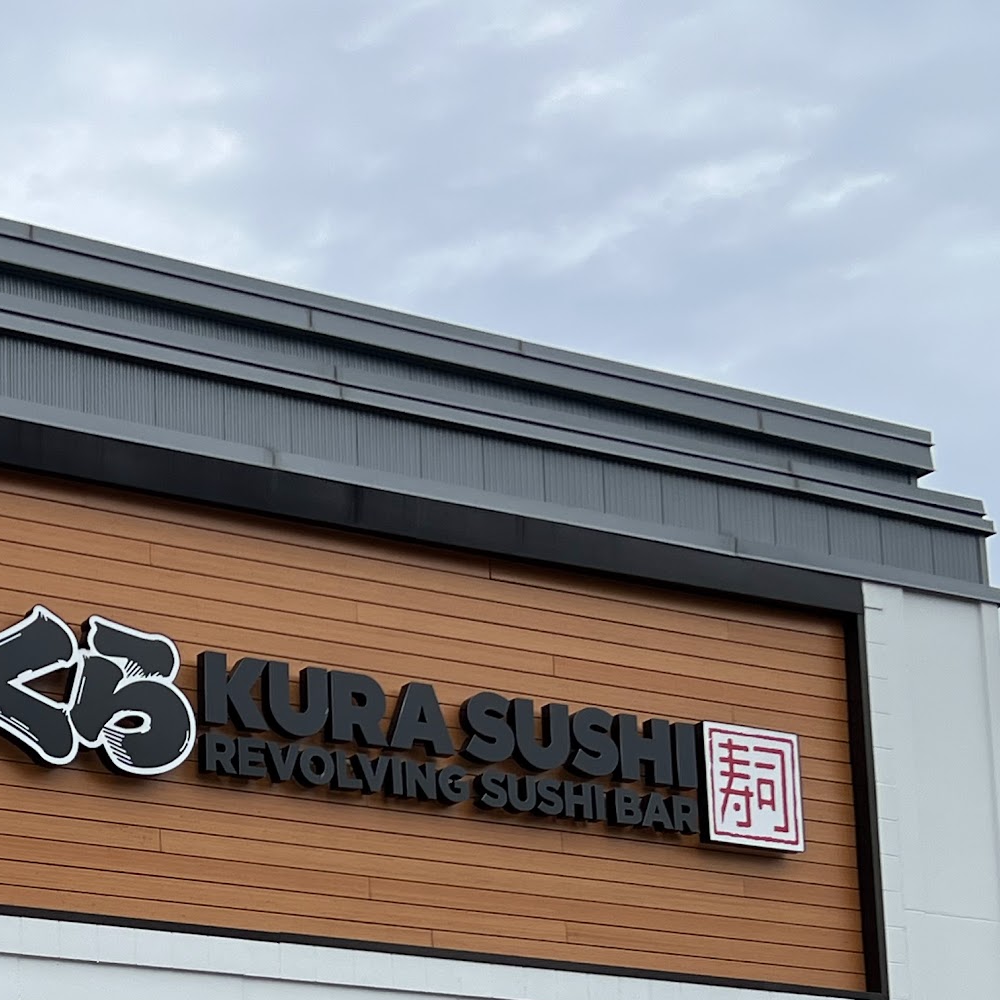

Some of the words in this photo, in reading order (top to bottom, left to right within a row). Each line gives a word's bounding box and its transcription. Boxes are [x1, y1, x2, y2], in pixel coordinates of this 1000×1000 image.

[198, 650, 454, 757] KURA
[461, 692, 698, 789] SUSHI
[202, 734, 470, 804] REVOLVING
[477, 770, 609, 822] SUSHI
[609, 788, 699, 833] BAR
